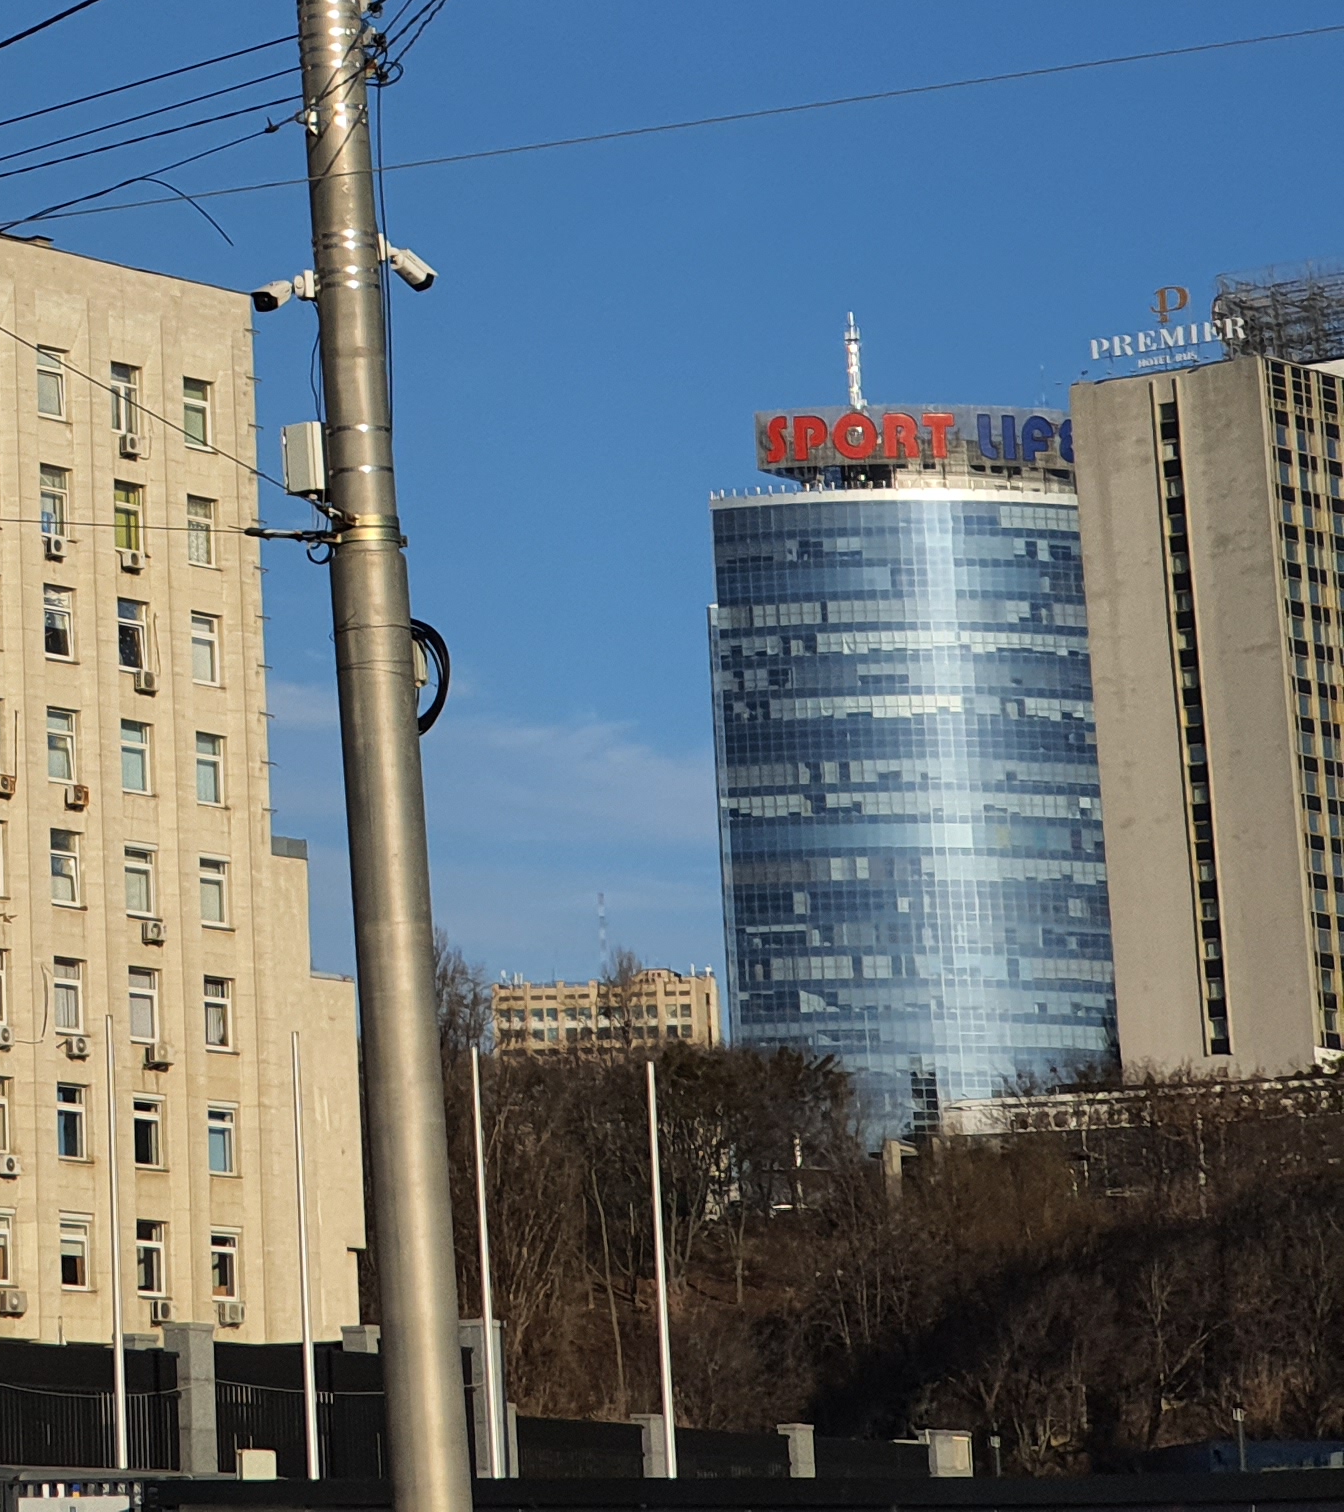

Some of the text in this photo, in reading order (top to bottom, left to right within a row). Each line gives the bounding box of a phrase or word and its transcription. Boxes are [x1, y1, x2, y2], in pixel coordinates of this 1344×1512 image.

[1090, 316, 1247, 361] PREMIER
[1137, 355, 1172, 368] HOTEL
[766, 412, 955, 464] SPORT
